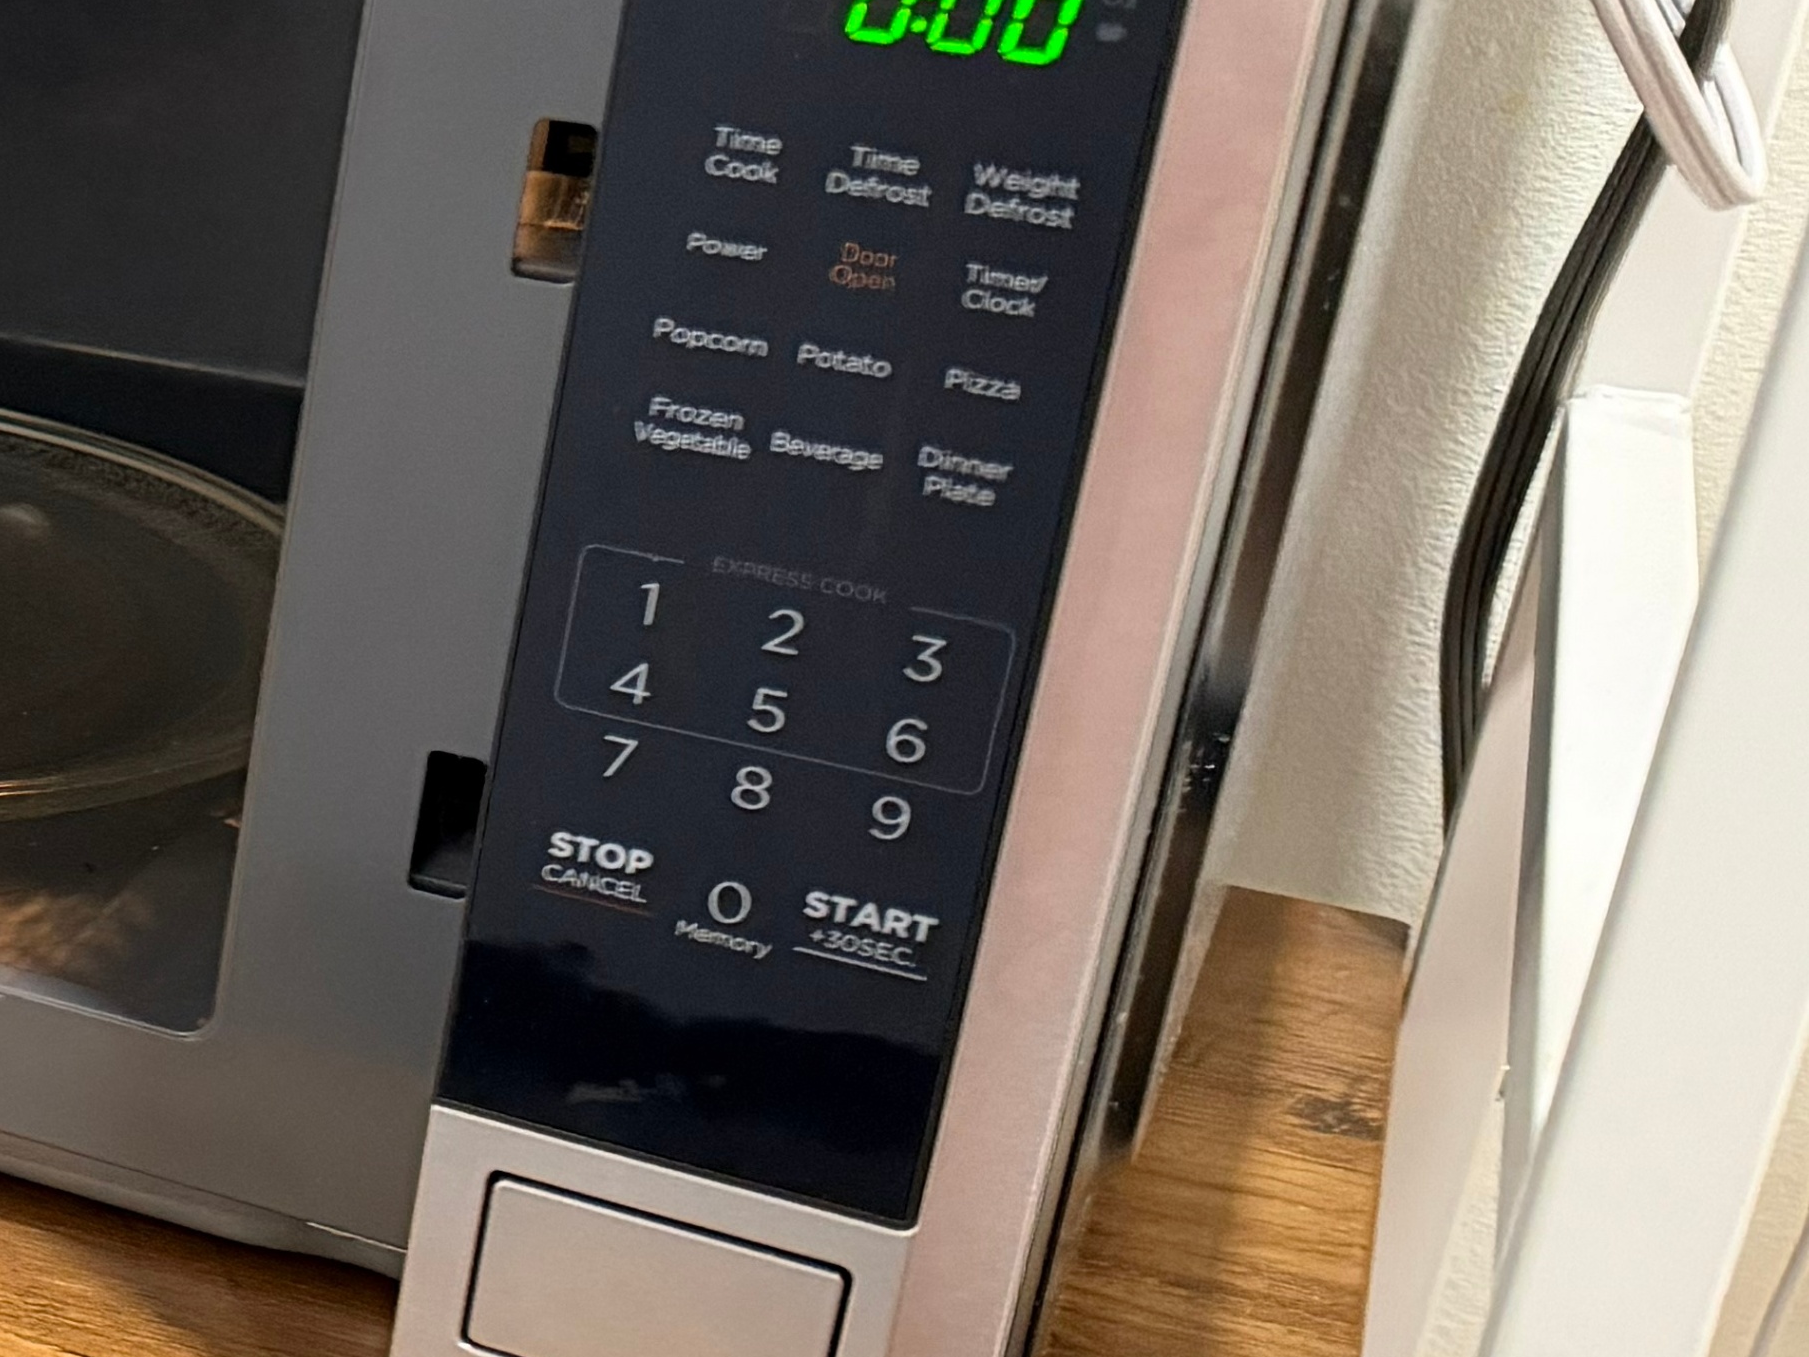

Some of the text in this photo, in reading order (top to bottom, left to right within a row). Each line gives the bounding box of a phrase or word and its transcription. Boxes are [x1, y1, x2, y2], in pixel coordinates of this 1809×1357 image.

[714, 125, 783, 155] Time
[704, 155, 777, 184] Cook
[850, 144, 920, 176] Time
[825, 171, 931, 208] Defrost
[972, 162, 1079, 201] Weight
[963, 192, 1073, 229] Defrost
[686, 233, 767, 261] Power
[840, 243, 897, 269] Door
[828, 264, 895, 292] Open
[966, 263, 1047, 293] Timer/
[961, 289, 1035, 317] Clock
[653, 318, 768, 356] Popcorn
[797, 344, 892, 378] Potato
[944, 368, 1020, 401] Pizza
[649, 397, 744, 430] Frozen
[632, 422, 751, 459] Vegetable
[770, 431, 883, 470] Beverage
[917, 446, 1012, 482] Dinner
[923, 476, 996, 506] Plate
[712, 556, 887, 604] EXPRESS COOK
[640, 583, 660, 625] 1
[761, 609, 805, 655] 2
[902, 634, 947, 682] 3
[609, 663, 651, 705] 4
[747, 687, 788, 732] 5
[603, 735, 639, 777] 7
[885, 718, 928, 763] 6
[730, 766, 773, 810] 8
[869, 796, 912, 840] 9
[547, 831, 654, 874] STOP
[541, 864, 647, 903] CANCEL
[708, 881, 752, 924] 0
[803, 891, 940, 943] START
[674, 920, 773, 960] Memory
